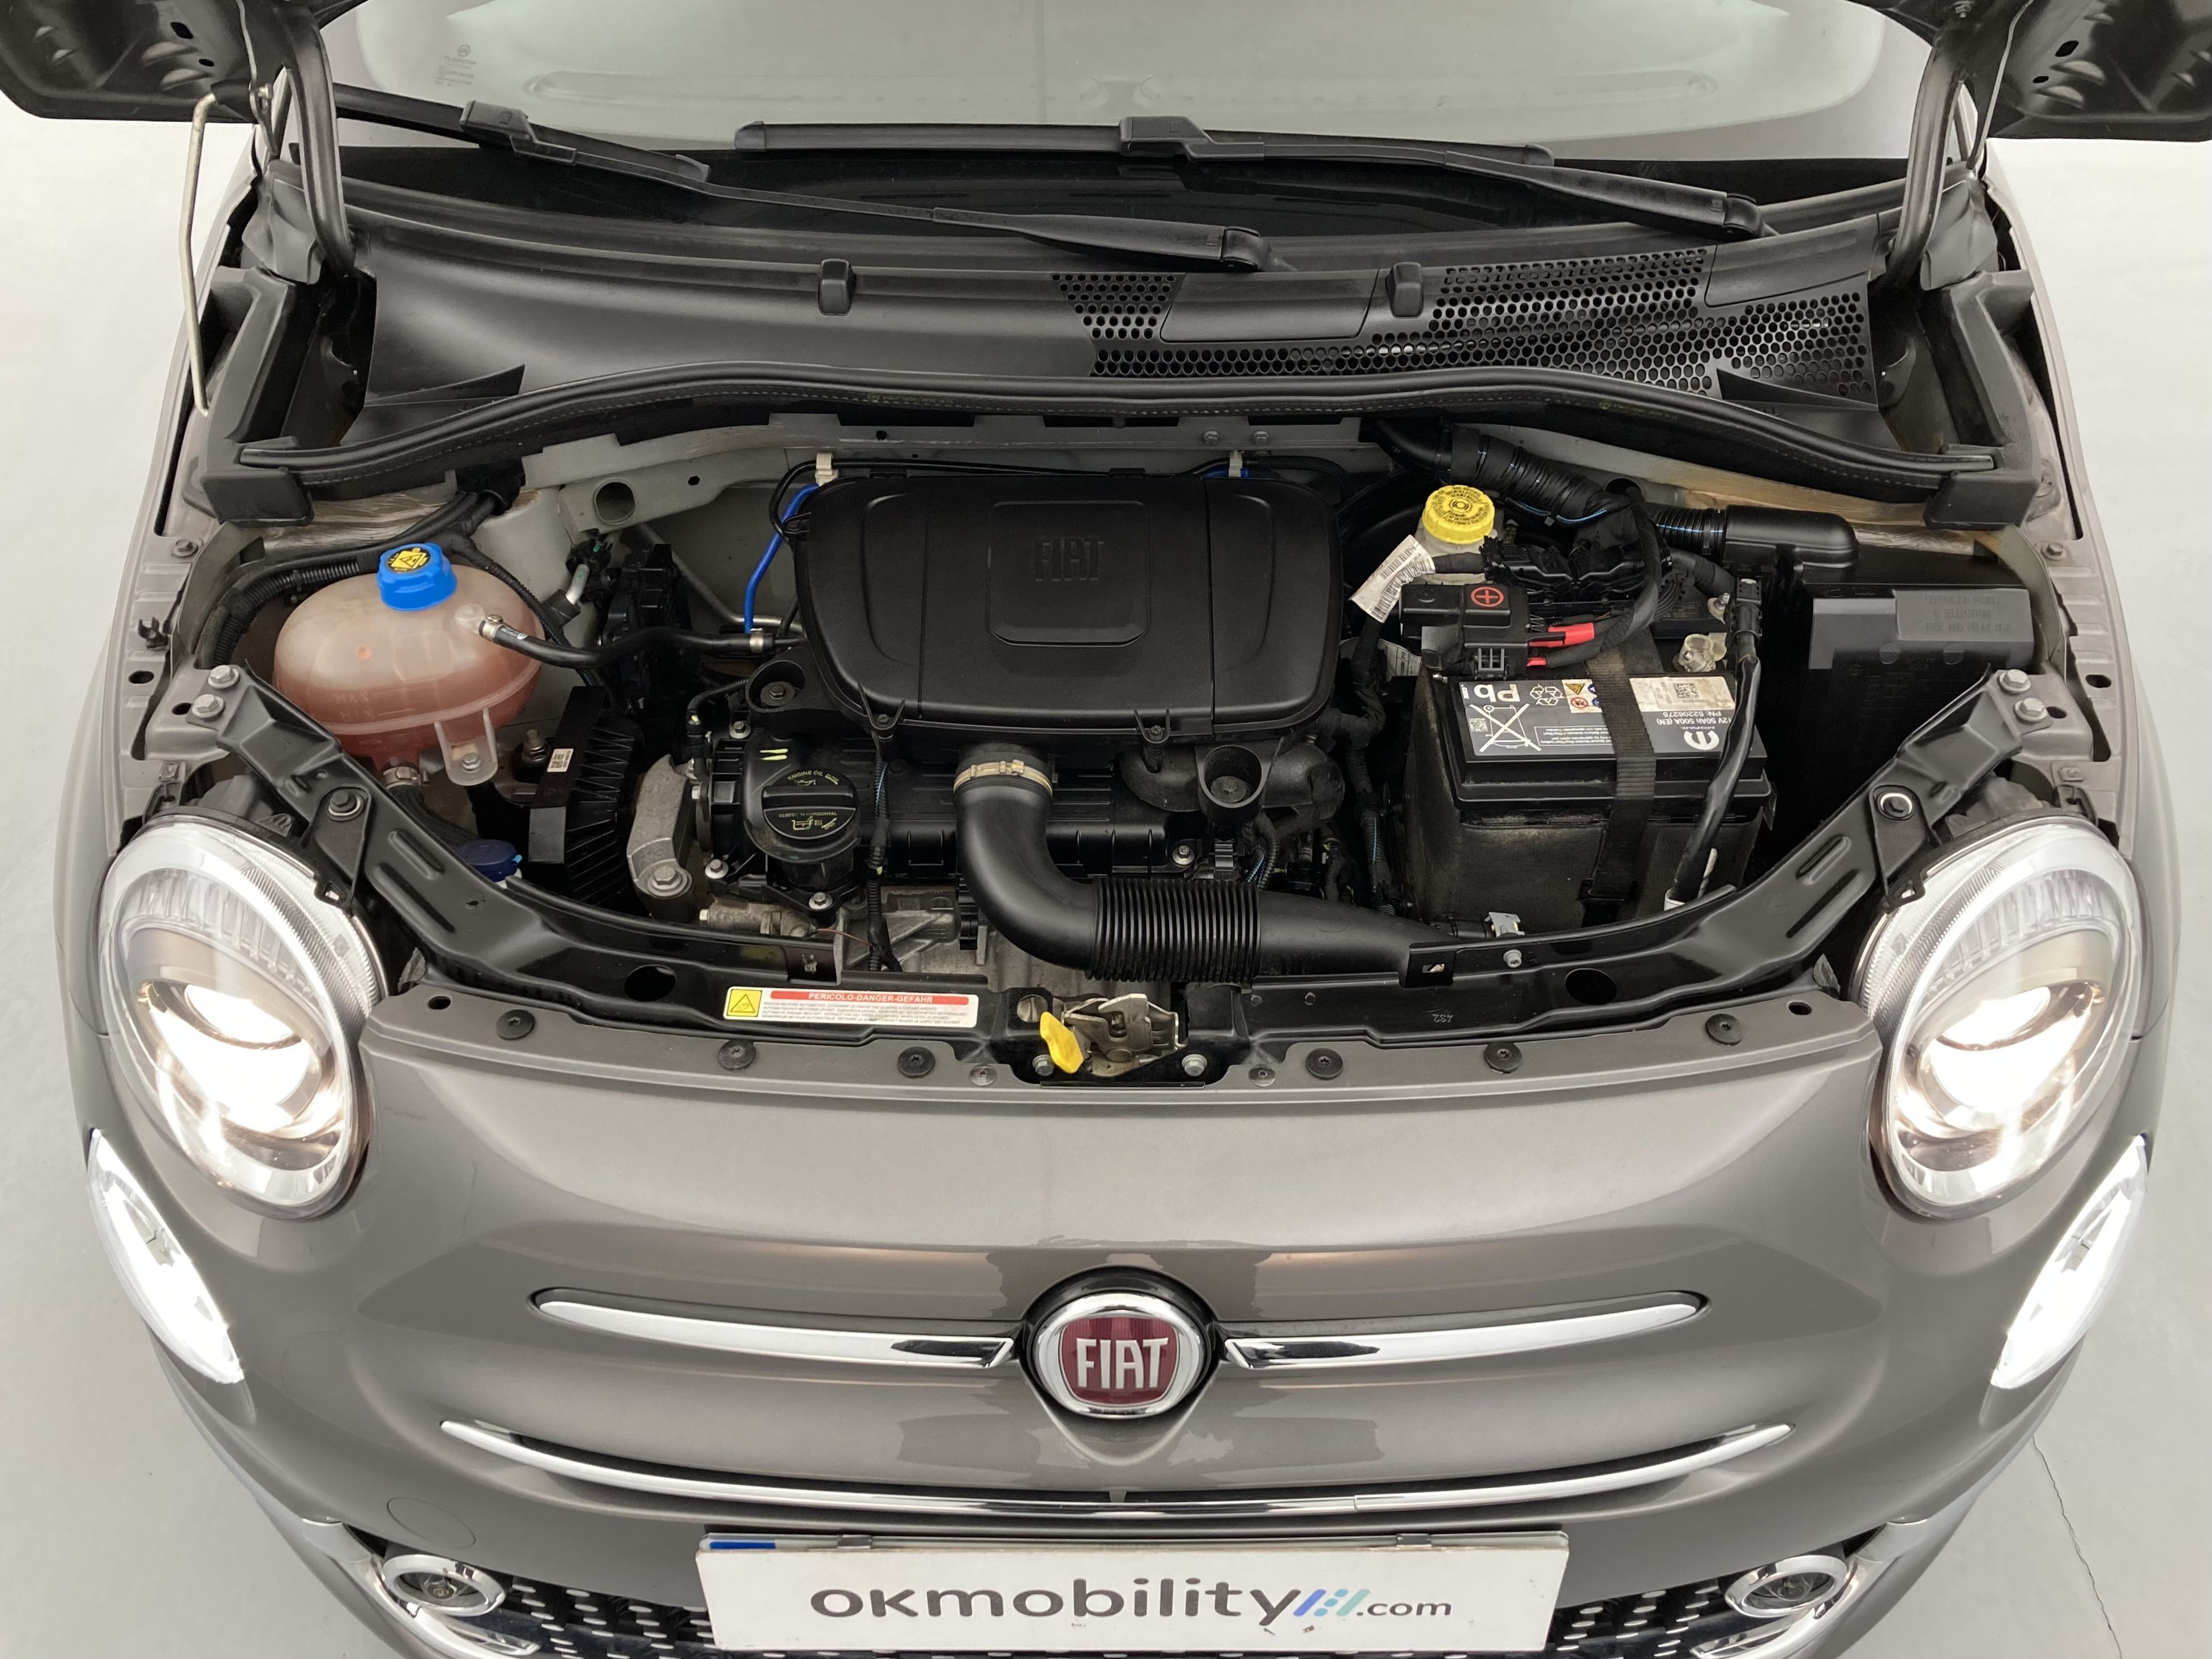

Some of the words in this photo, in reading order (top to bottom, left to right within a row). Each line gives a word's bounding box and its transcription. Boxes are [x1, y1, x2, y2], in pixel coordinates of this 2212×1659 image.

[1033, 537, 1105, 581] FIAT
[1474, 684, 1520, 703] Pb
[788, 770, 812, 780] ENGINE
[808, 992, 934, 1003] PERICOLO-DANGER-GEFAHR
[1076, 1337, 1169, 1389] FIAT
[810, 1578, 1302, 1627] okmobility
[1355, 1596, 1453, 1618] .com
